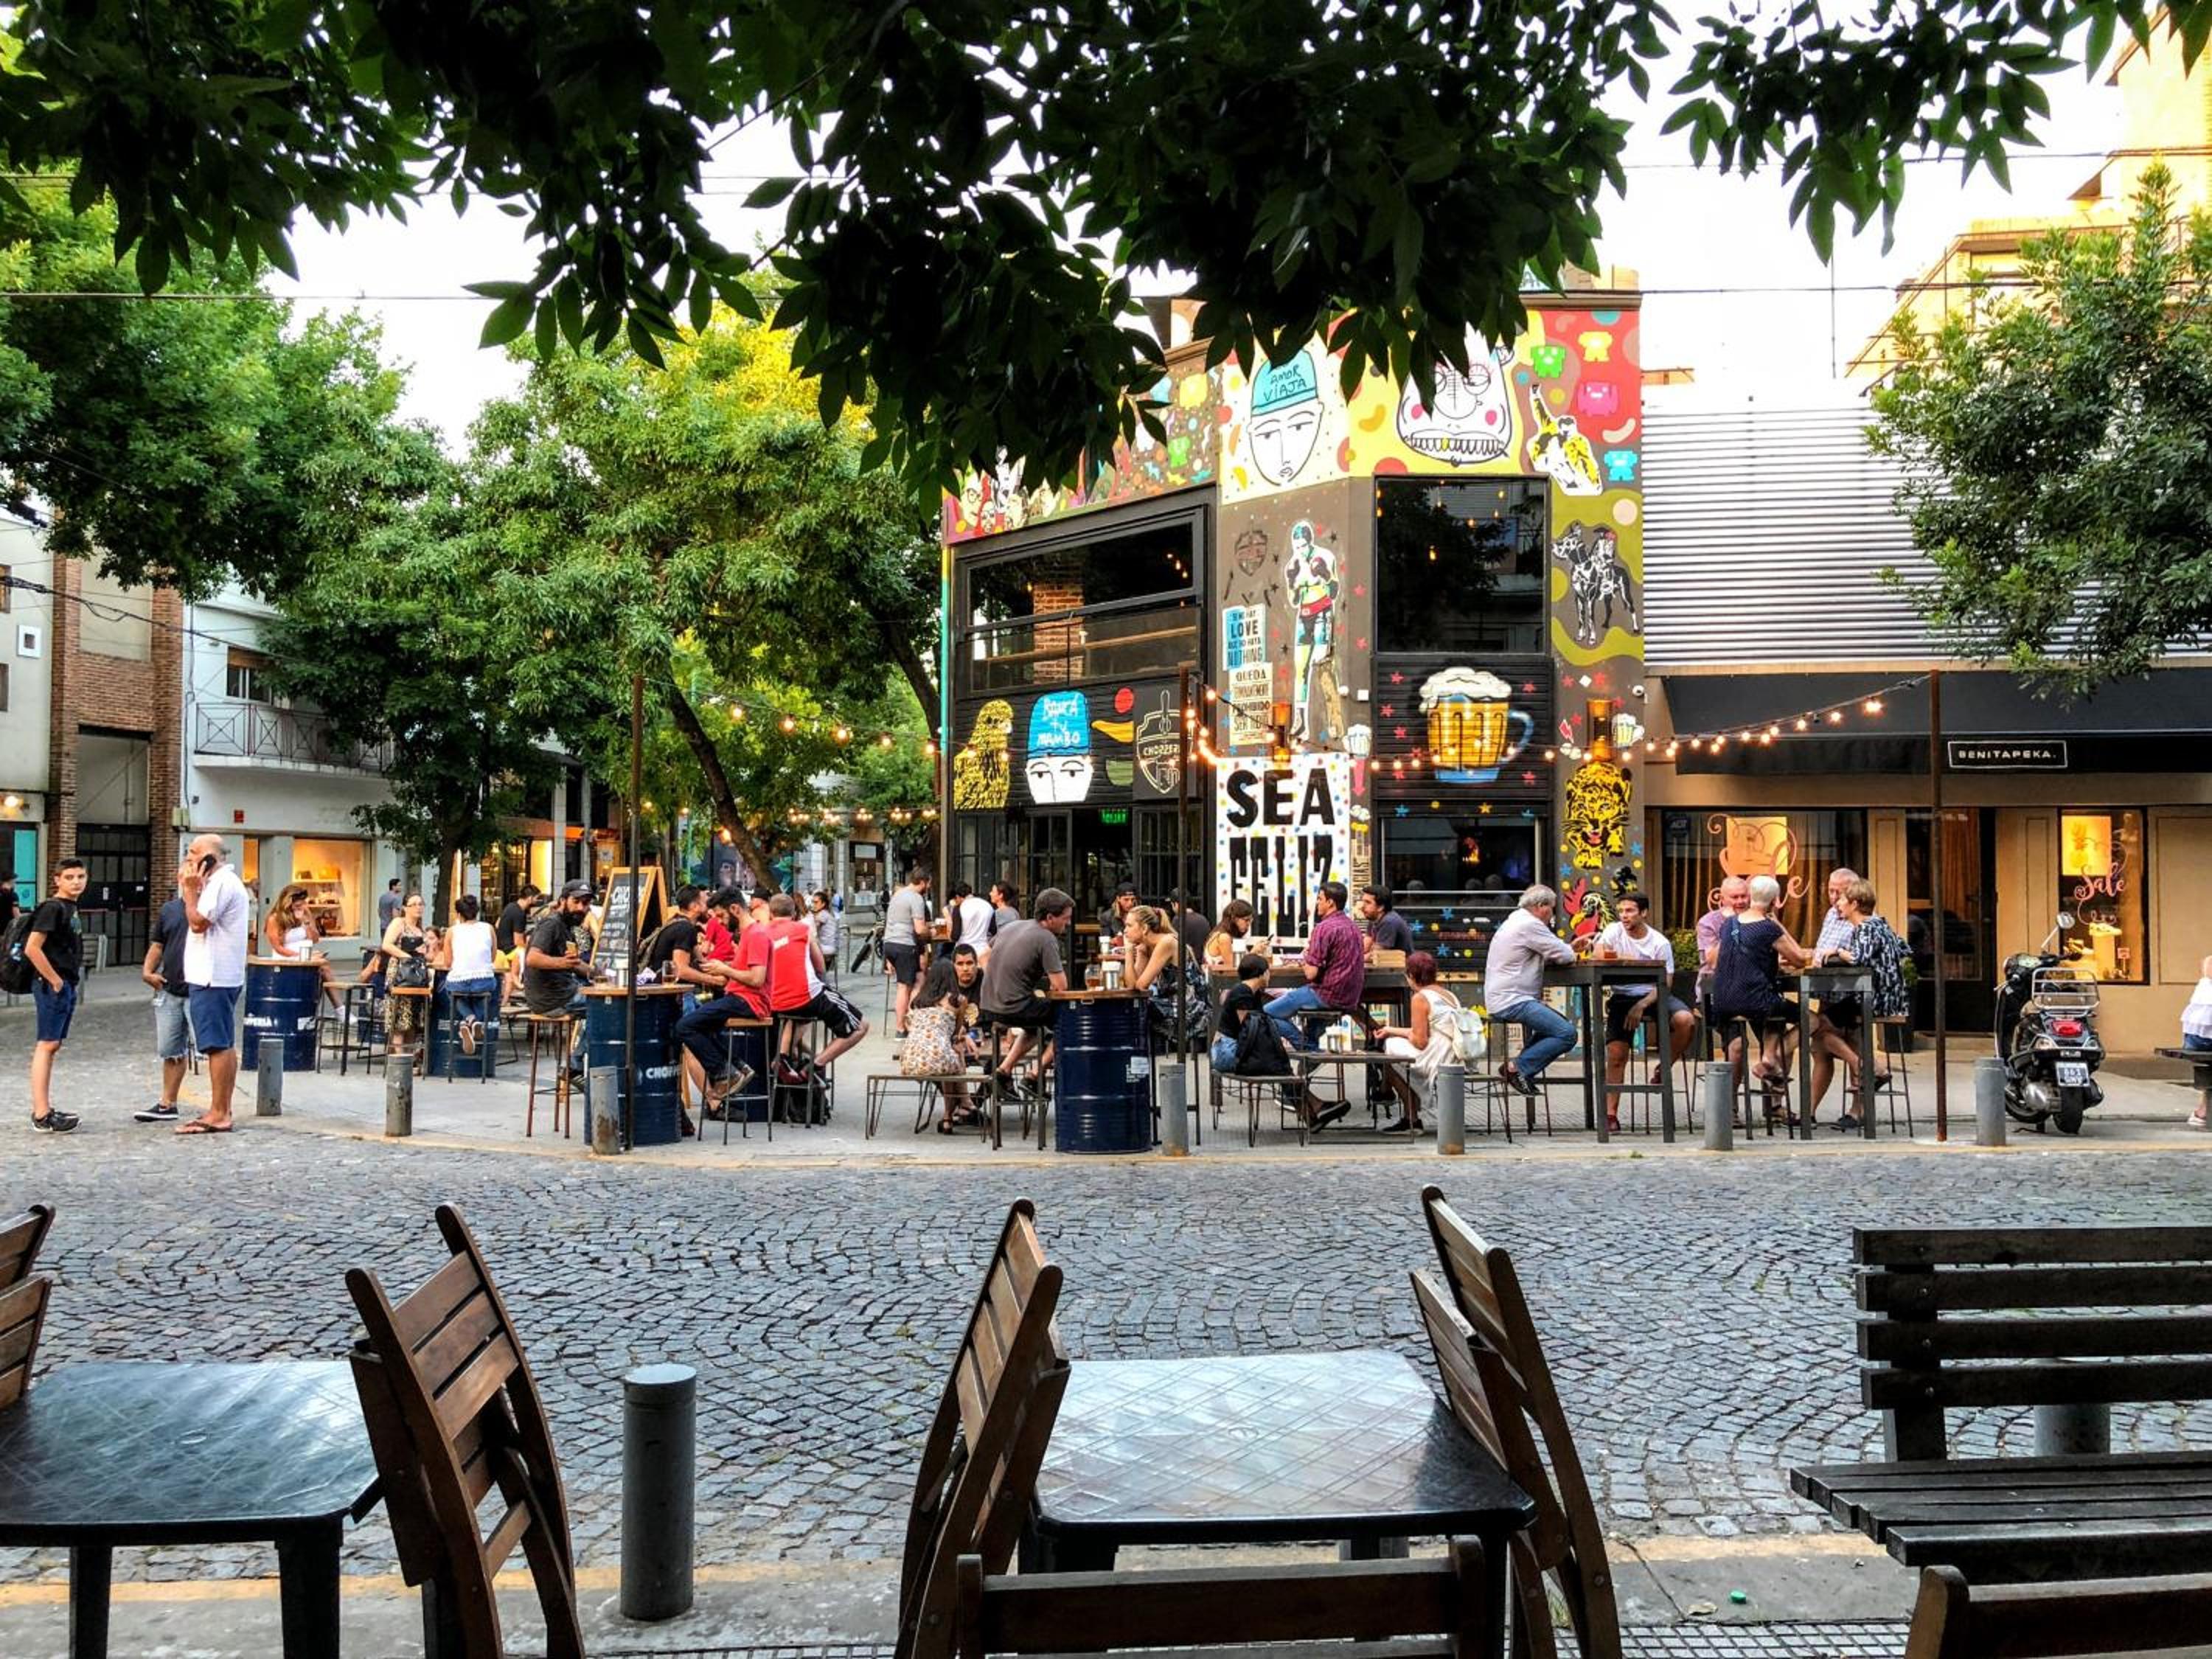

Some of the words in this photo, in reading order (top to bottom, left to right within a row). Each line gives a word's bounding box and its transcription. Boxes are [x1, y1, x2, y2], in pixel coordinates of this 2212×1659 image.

[1231, 619, 1258, 639] LOVE
[1227, 647, 1263, 667] NOTHING
[1236, 668, 1267, 682] QUEDA
[1226, 768, 1335, 828] SEA
[1229, 834, 1333, 938] FELIZ
[2074, 862, 2126, 901] Sale
